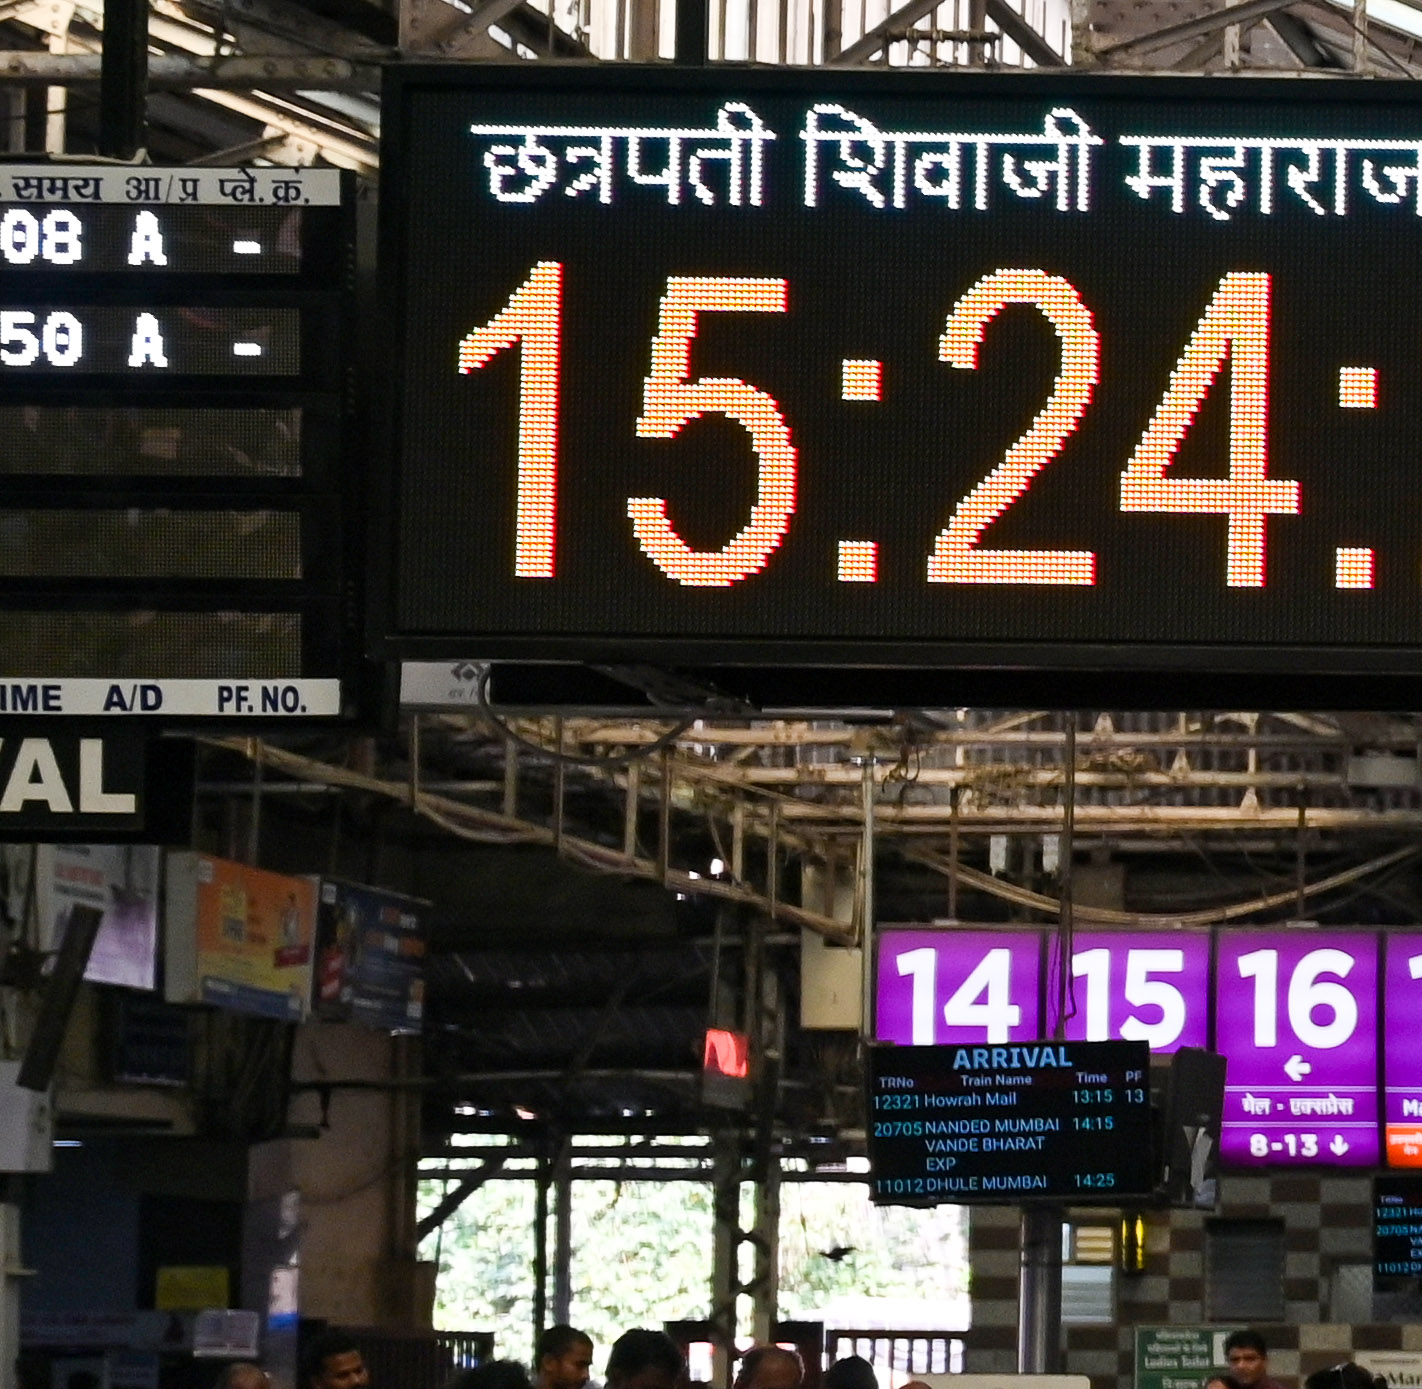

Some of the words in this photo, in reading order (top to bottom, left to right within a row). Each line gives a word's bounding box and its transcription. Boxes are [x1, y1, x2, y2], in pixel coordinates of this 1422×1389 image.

[471, 102, 776, 206] छत्रपती
[800, 104, 1103, 211] शिवाजी
[12, 176, 103, 200] समय
[128, 211, 167, 265] A
[0, 311, 82, 366] 50
[129, 313, 167, 367] A
[103, 684, 163, 713] A/D
[261, 685, 307, 713] NO.
[0, 736, 136, 814] AL
[896, 948, 1020, 1045] 14
[1071, 949, 1186, 1053] 15
[1237, 949, 1358, 1049] 16
[953, 1046, 1073, 1069] ARRIVAL
[880, 1077, 914, 1089] TRNo
[961, 1075, 992, 1087] Train
[996, 1074, 1032, 1086] Name
[1076, 1072, 1107, 1084] Time
[1125, 1070, 1142, 1082] PF
[875, 1095, 919, 1110] 12321
[924, 1092, 981, 1107] Howrah
[986, 1092, 1017, 1105] Mail
[1072, 1089, 1112, 1104] 13:15
[1125, 1089, 1144, 1103] 13
[874, 1121, 922, 1137] 20705
[925, 1120, 990, 1135] NANDED
[995, 1118, 1060, 1133] MUMBAI
[1073, 1116, 1114, 1130] 14:15
[925, 1138, 978, 1153] VANDE
[983, 1136, 1045, 1150] BHARAT
[1250, 1133, 1318, 1157] 8-13
[926, 1157, 956, 1171] EXP
[877, 1179, 924, 1193] 11012
[927, 1178, 978, 1191] DHULE
[982, 1175, 1047, 1189] MUMBAI
[1074, 1173, 1115, 1187] 14:25
